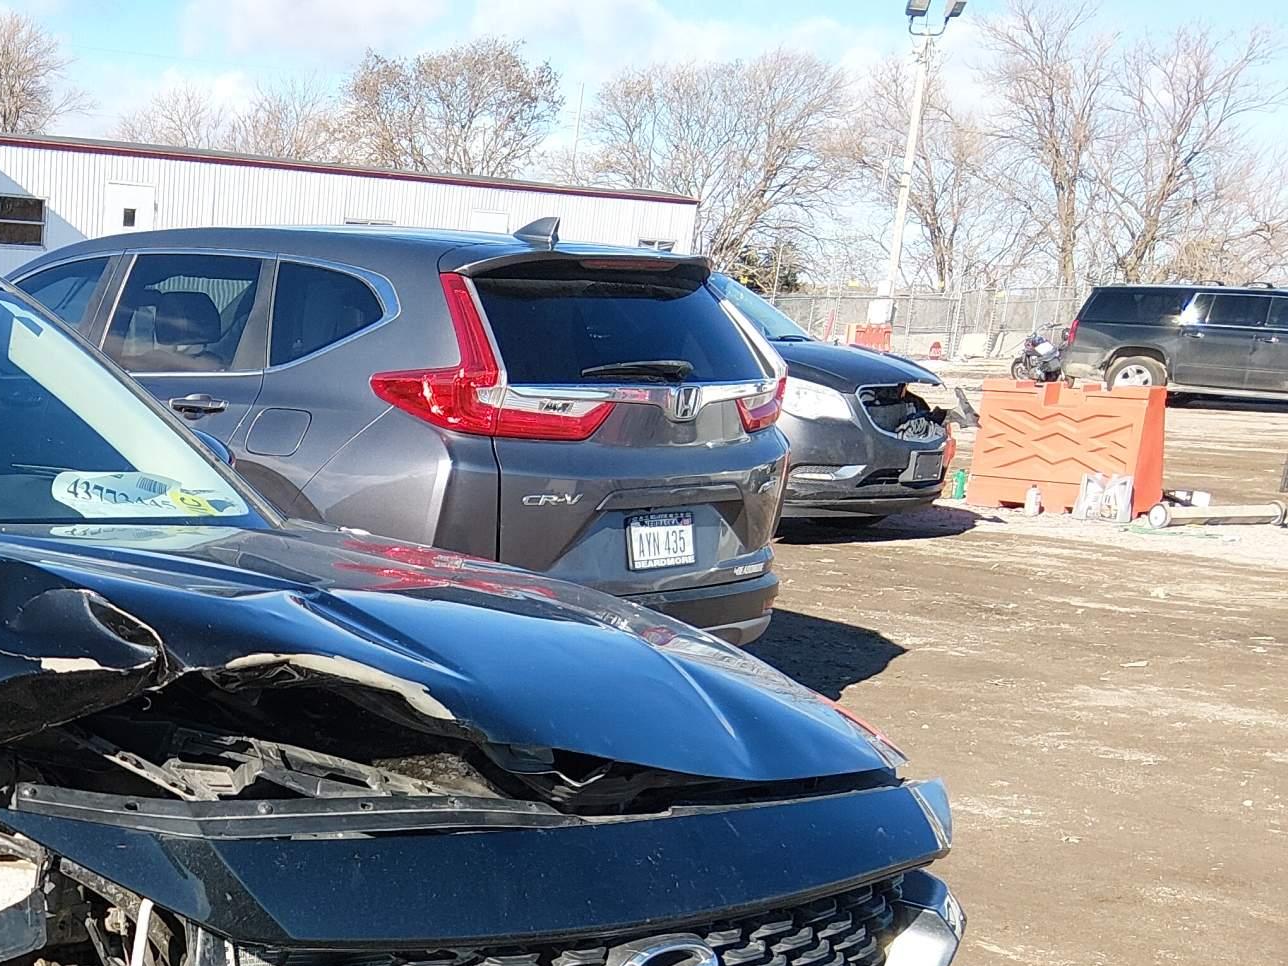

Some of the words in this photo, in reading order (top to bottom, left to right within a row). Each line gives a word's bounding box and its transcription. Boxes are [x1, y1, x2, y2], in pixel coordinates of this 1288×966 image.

[522, 492, 585, 506] CR-V
[639, 531, 661, 558] AYN
[665, 529, 686, 555] 435
